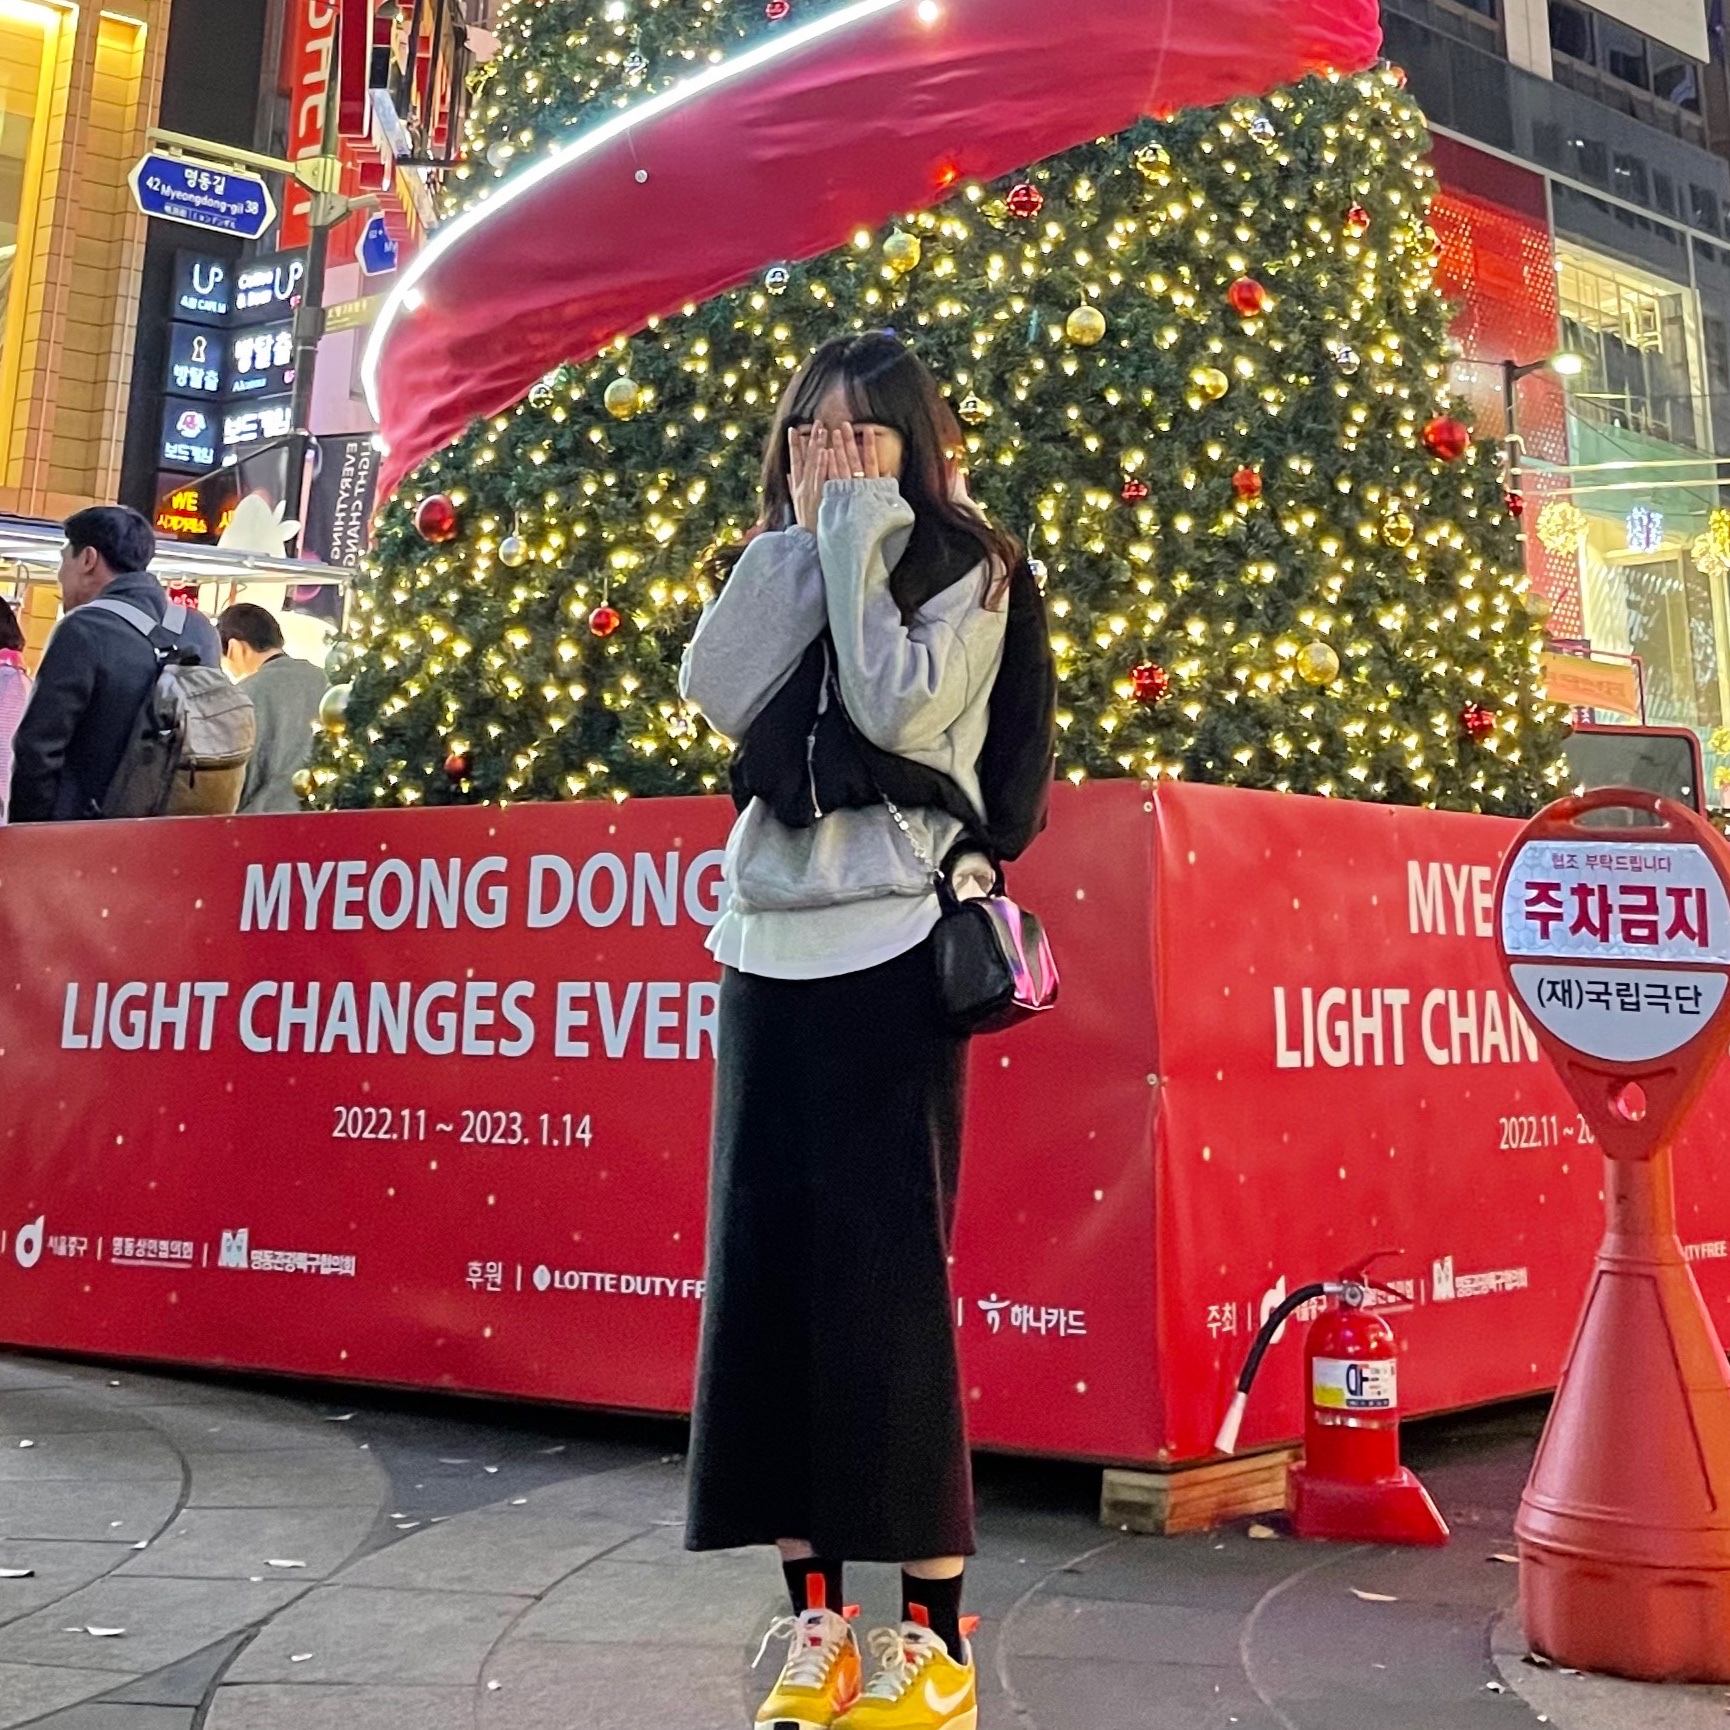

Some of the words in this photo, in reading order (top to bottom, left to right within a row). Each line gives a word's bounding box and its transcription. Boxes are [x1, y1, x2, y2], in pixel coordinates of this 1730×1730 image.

[146, 176, 161, 192] 42
[160, 184, 244, 215] Myeongdong-gil
[245, 200, 260, 215] 38
[184, 168, 226, 195] 명동길
[171, 491, 199, 512] WE
[1585, 854, 1672, 873] 부탁드립니다
[240, 856, 508, 932] MYEONG
[527, 850, 726, 929] DONG
[1407, 860, 1493, 937] MYE
[1524, 881, 1709, 948] 주차금지
[1537, 978, 1702, 1015] (재)국립극단
[61, 981, 229, 1051] LIGHT
[239, 980, 535, 1056] CHANGES
[554, 981, 719, 1060] EVER
[1273, 986, 1410, 1068] LIGHT
[1421, 988, 1539, 1065] CHAN
[332, 1106, 426, 1141] 2022.11
[459, 1110, 529, 1145] 2023.
[539, 1113, 592, 1147] 1.14
[1499, 1115, 1558, 1149] 2022.11
[466, 1261, 502, 1292] 후원
[553, 1270, 617, 1293] LOTTE
[620, 1275, 678, 1297] DUTY
[1011, 1303, 1087, 1337] 하나카드
[1207, 1302, 1237, 1339] 주최
